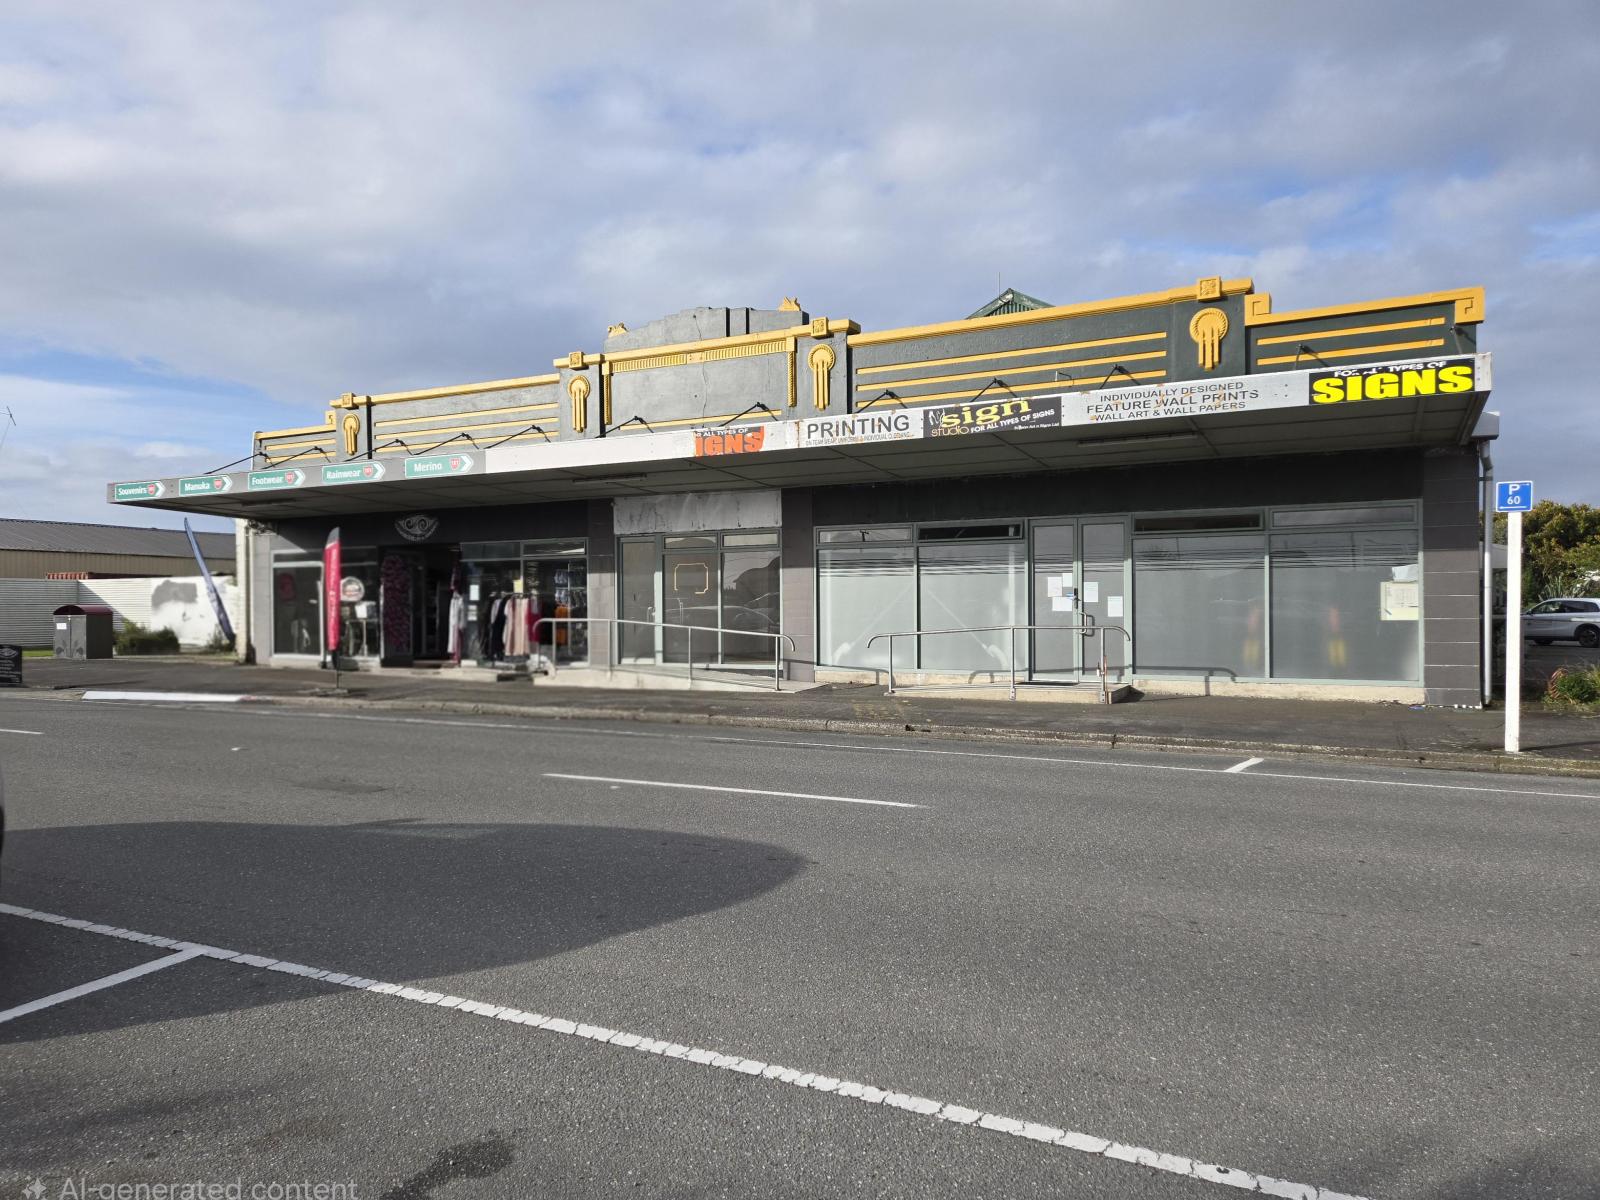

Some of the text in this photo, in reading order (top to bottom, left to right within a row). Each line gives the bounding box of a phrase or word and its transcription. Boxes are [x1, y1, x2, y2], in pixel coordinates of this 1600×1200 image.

[1388, 362, 1425, 372] TYPES
[1426, 361, 1447, 370] OF
[1312, 365, 1473, 404] SIGNS
[1100, 382, 1243, 402] INDIVIDUALLY DESIGNED
[1087, 389, 1259, 414] FEATURE WALL PRINTS
[942, 399, 1032, 428] sign
[1095, 401, 1245, 422] WALL ART & WALL PAPERS
[807, 414, 910, 439] PRINTING
[971, 426, 985, 434] FOR
[987, 422, 999, 431] ALL
[1000, 417, 1019, 427] TYPES
[1032, 408, 1056, 419] SIGNS
[931, 425, 970, 437] studio
[414, 461, 443, 472] Merino
[327, 468, 361, 479] Rainwear
[252, 476, 284, 486] Footwear
[118, 486, 148, 496] Souvenirs
[1509, 484, 1520, 495] P
[1507, 496, 1521, 505] 60
